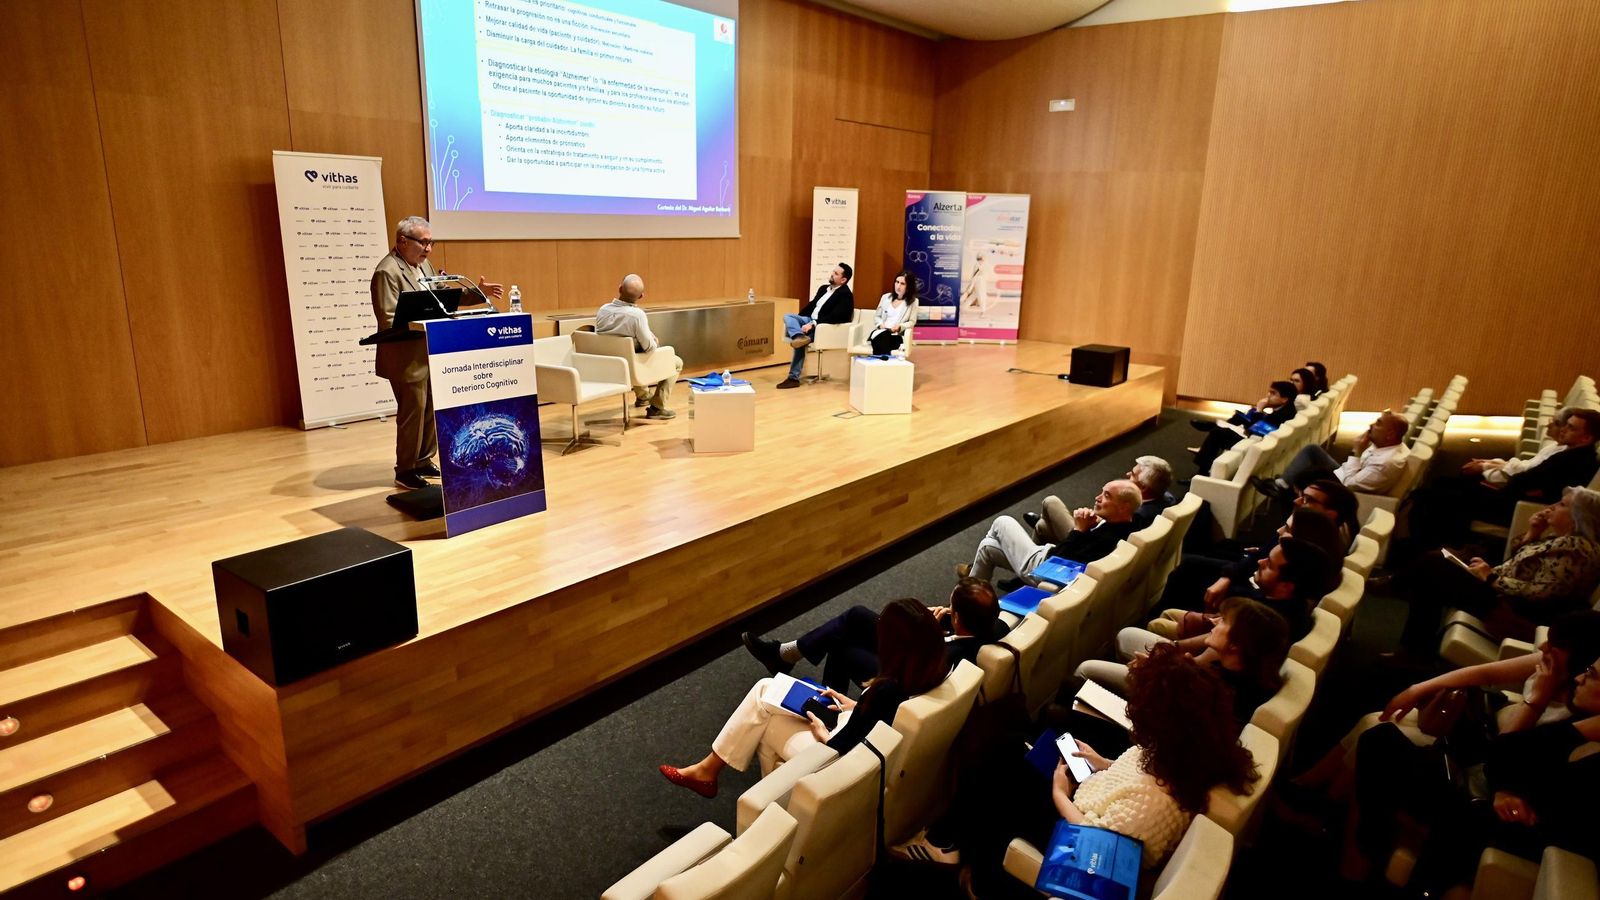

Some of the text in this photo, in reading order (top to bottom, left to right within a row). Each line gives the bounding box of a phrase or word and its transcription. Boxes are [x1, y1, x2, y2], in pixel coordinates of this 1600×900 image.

[509, 21, 528, 30] calidad
[486, 29, 513, 40] Disminuir
[521, 38, 536, 48] carga
[488, 59, 526, 72] Diagnosticar
[489, 70, 518, 80] exigencia
[532, 78, 552, 86] muchos
[505, 122, 523, 131] Aporta
[506, 134, 524, 142] Aporta
[322, 172, 358, 183] vithas
[498, 326, 522, 335] vithas
[442, 358, 524, 374] Jornada Interdisciplinar
[473, 372, 493, 380] sobre
[452, 379, 518, 394] Deterioro Cognitivo
